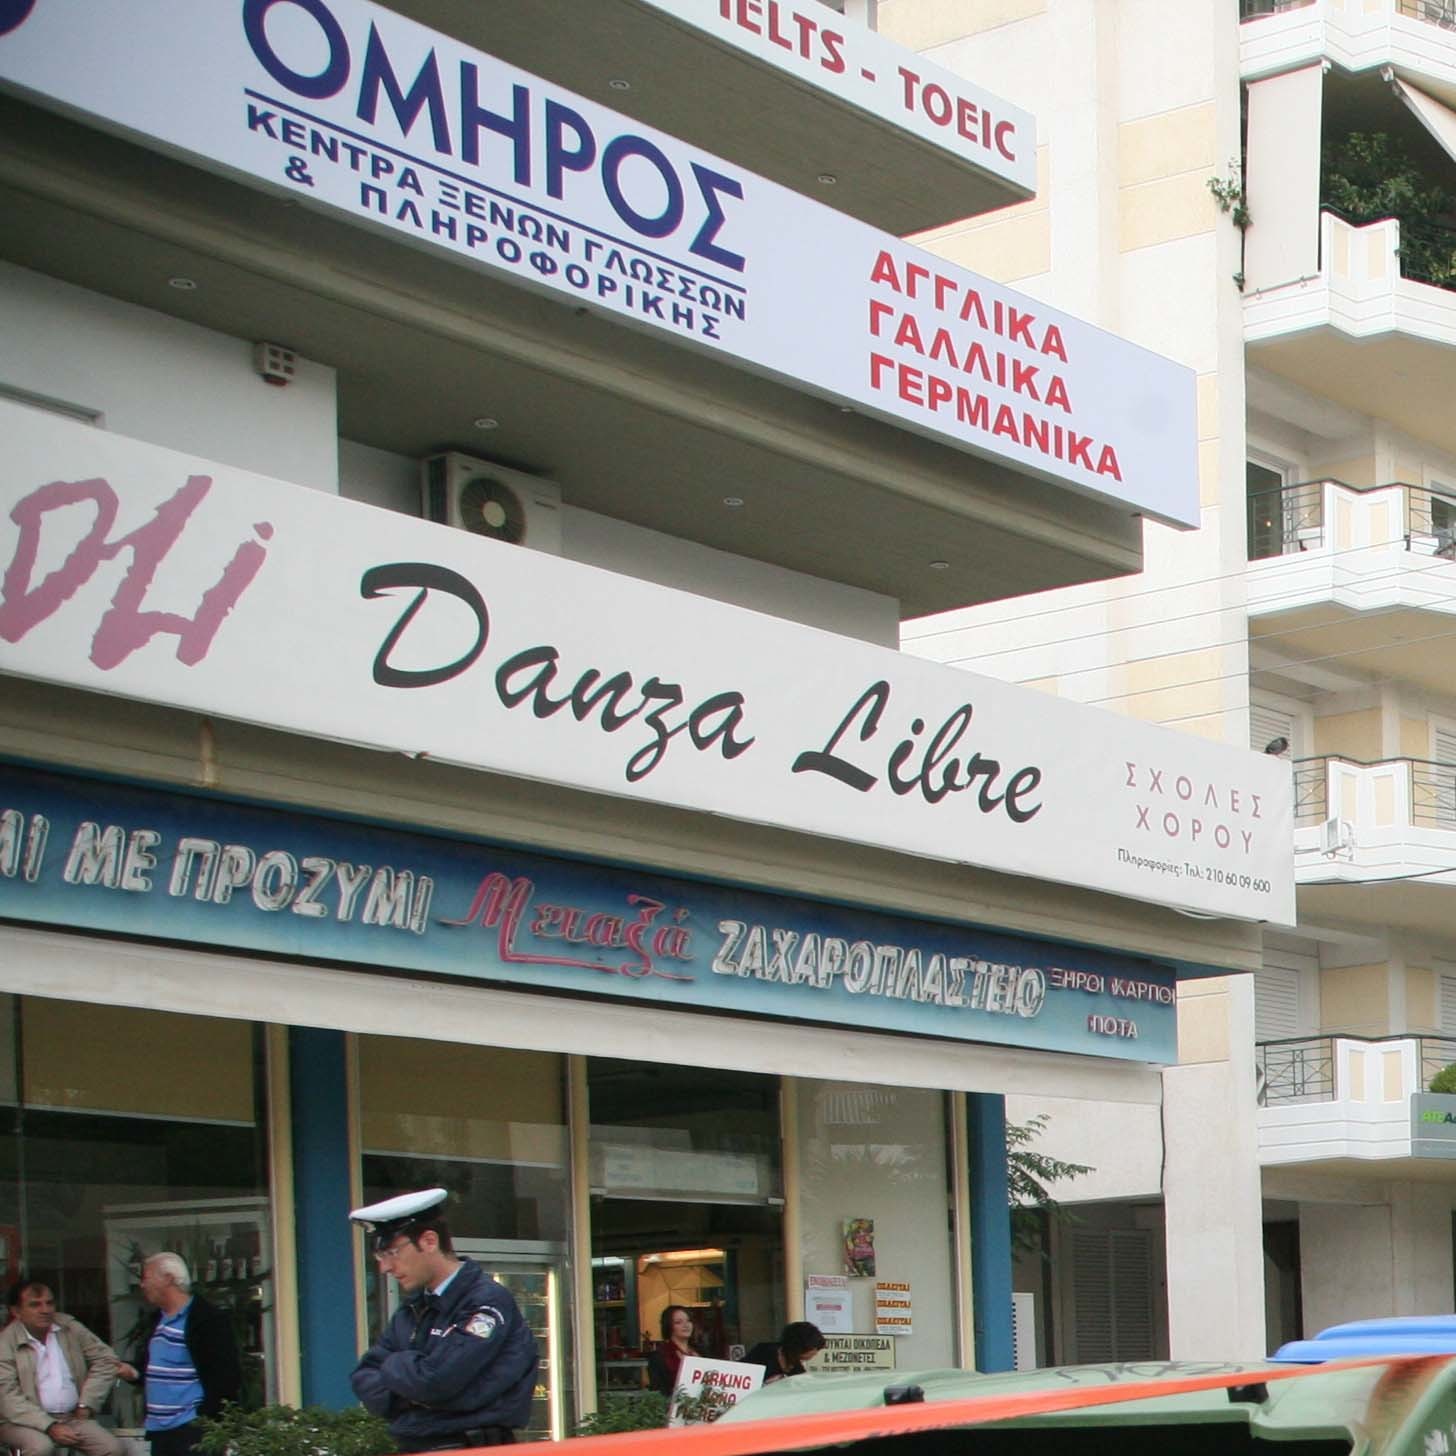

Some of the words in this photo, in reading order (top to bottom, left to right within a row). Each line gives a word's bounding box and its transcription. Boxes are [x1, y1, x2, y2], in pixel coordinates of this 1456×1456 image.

[242, 0, 745, 273] ΟΜΗΡΟΣ
[898, 66, 1015, 162] TOEIC
[247, 104, 424, 196] ΚΕΝΤΡΑ
[439, 180, 571, 253] ΞΕΝΩΝ
[584, 237, 746, 320] ΓΛΩΣΣΩΝ
[285, 156, 315, 186] &
[360, 183, 721, 340] ΠΛΗΡΟΦΟΡΙΚΗΣ
[869, 299, 1072, 414] ΓΑΛΛΙΚΑ
[871, 250, 1069, 364] ΑΓΓΛΙΚΑ
[869, 352, 1123, 481] ΓΕΡΜΑΝΙΚΑ
[360, 562, 755, 782] Danza
[791, 680, 1043, 823] Libre
[1126, 761, 1262, 819] ΣΧΟΛΕΣ
[1135, 804, 1253, 855] ΧΟΡΟΥ
[63, 820, 161, 893] ΜΕ
[169, 837, 434, 935] ΠΡΟΖΥΜΙ
[711, 919, 1045, 1018] ΖΑΧΑΡΟΠΛΑΣΤΕΙΟ
[1050, 967, 1104, 994] ΞΗΡΟΙ
[1112, 976, 1176, 1006] ΚΑΡΠΟΙ
[1205, 867, 1224, 884] 210
[1225, 872, 1237, 887] 60
[1239, 875, 1251, 889] 09
[1253, 878, 1271, 894] 600
[1090, 1014, 1138, 1039] ΠΟΤΑ
[692, 1369, 752, 1390] PARKING
